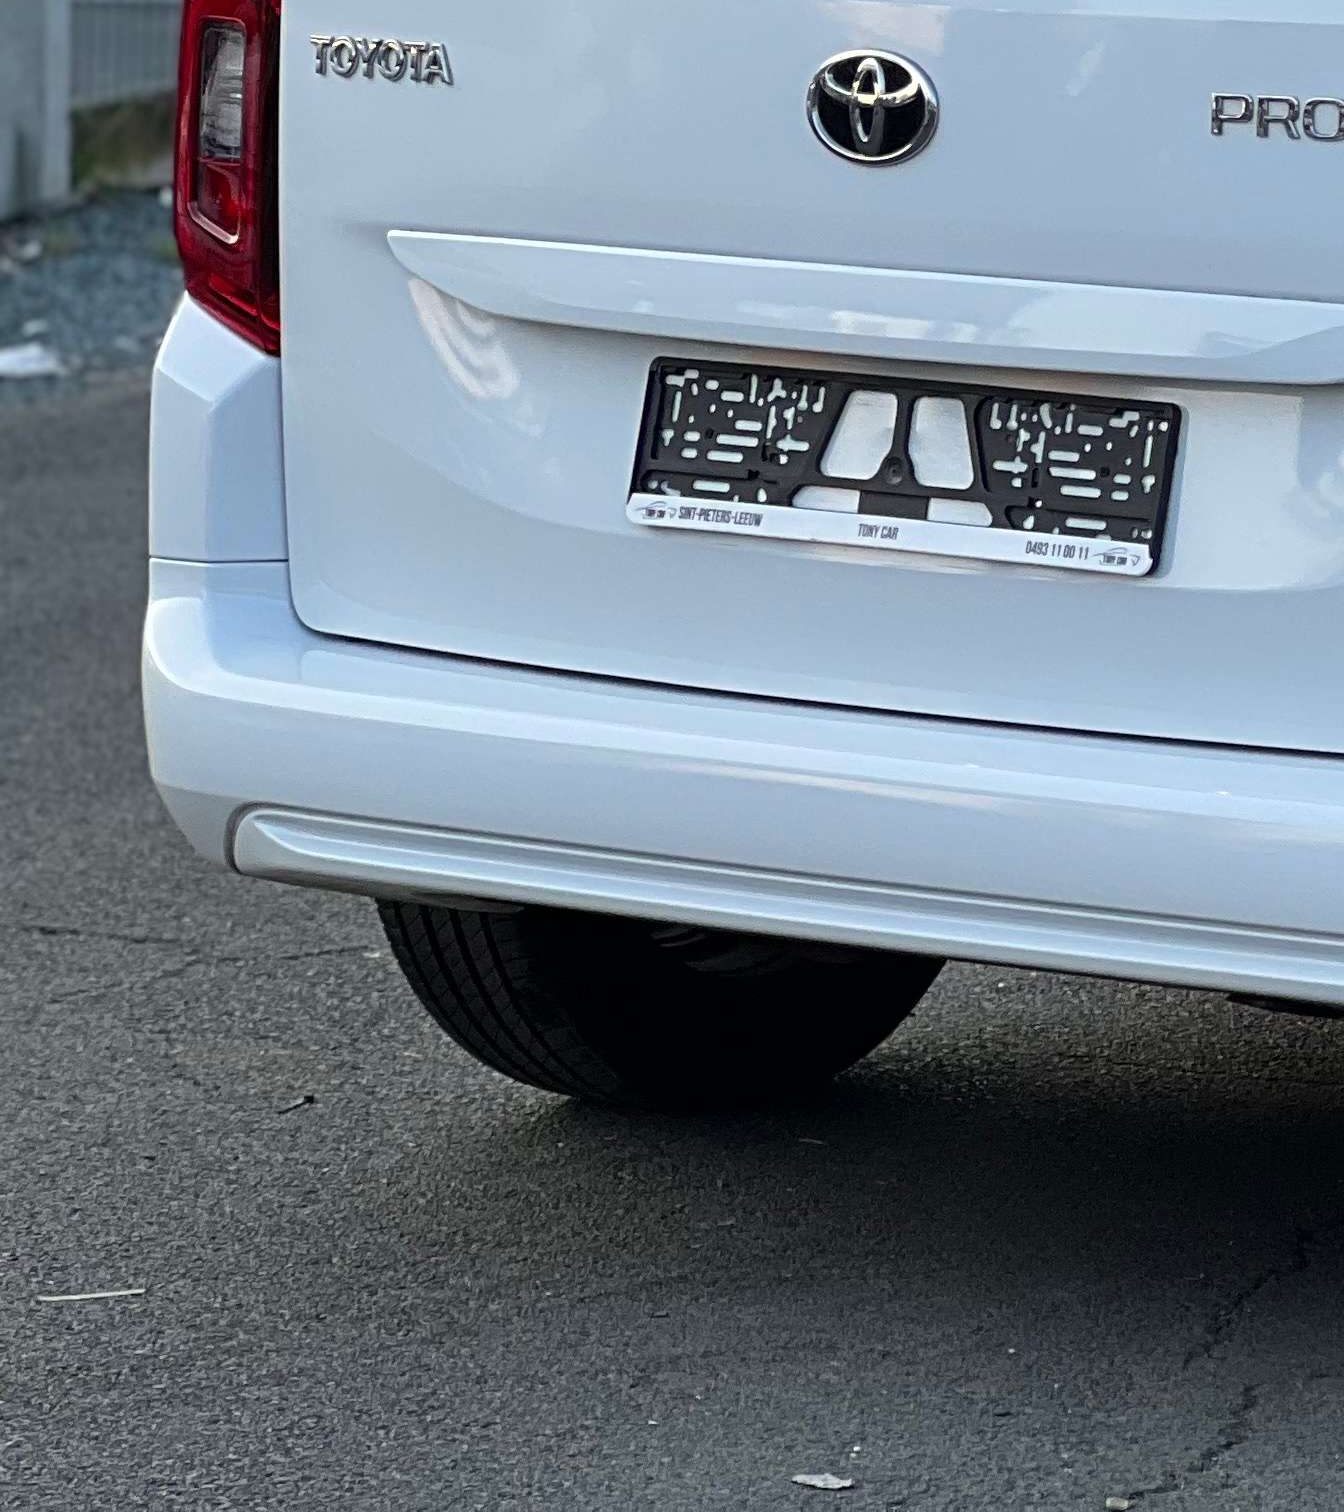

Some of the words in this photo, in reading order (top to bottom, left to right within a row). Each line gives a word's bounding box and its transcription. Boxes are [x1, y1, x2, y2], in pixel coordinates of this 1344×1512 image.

[310, 33, 454, 85] TOYOTA
[858, 523, 880, 539] TONY
[881, 525, 899, 540] CAR
[1025, 540, 1049, 556] 0493
[1052, 543, 1062, 557] 11
[1079, 546, 1090, 560] 11
